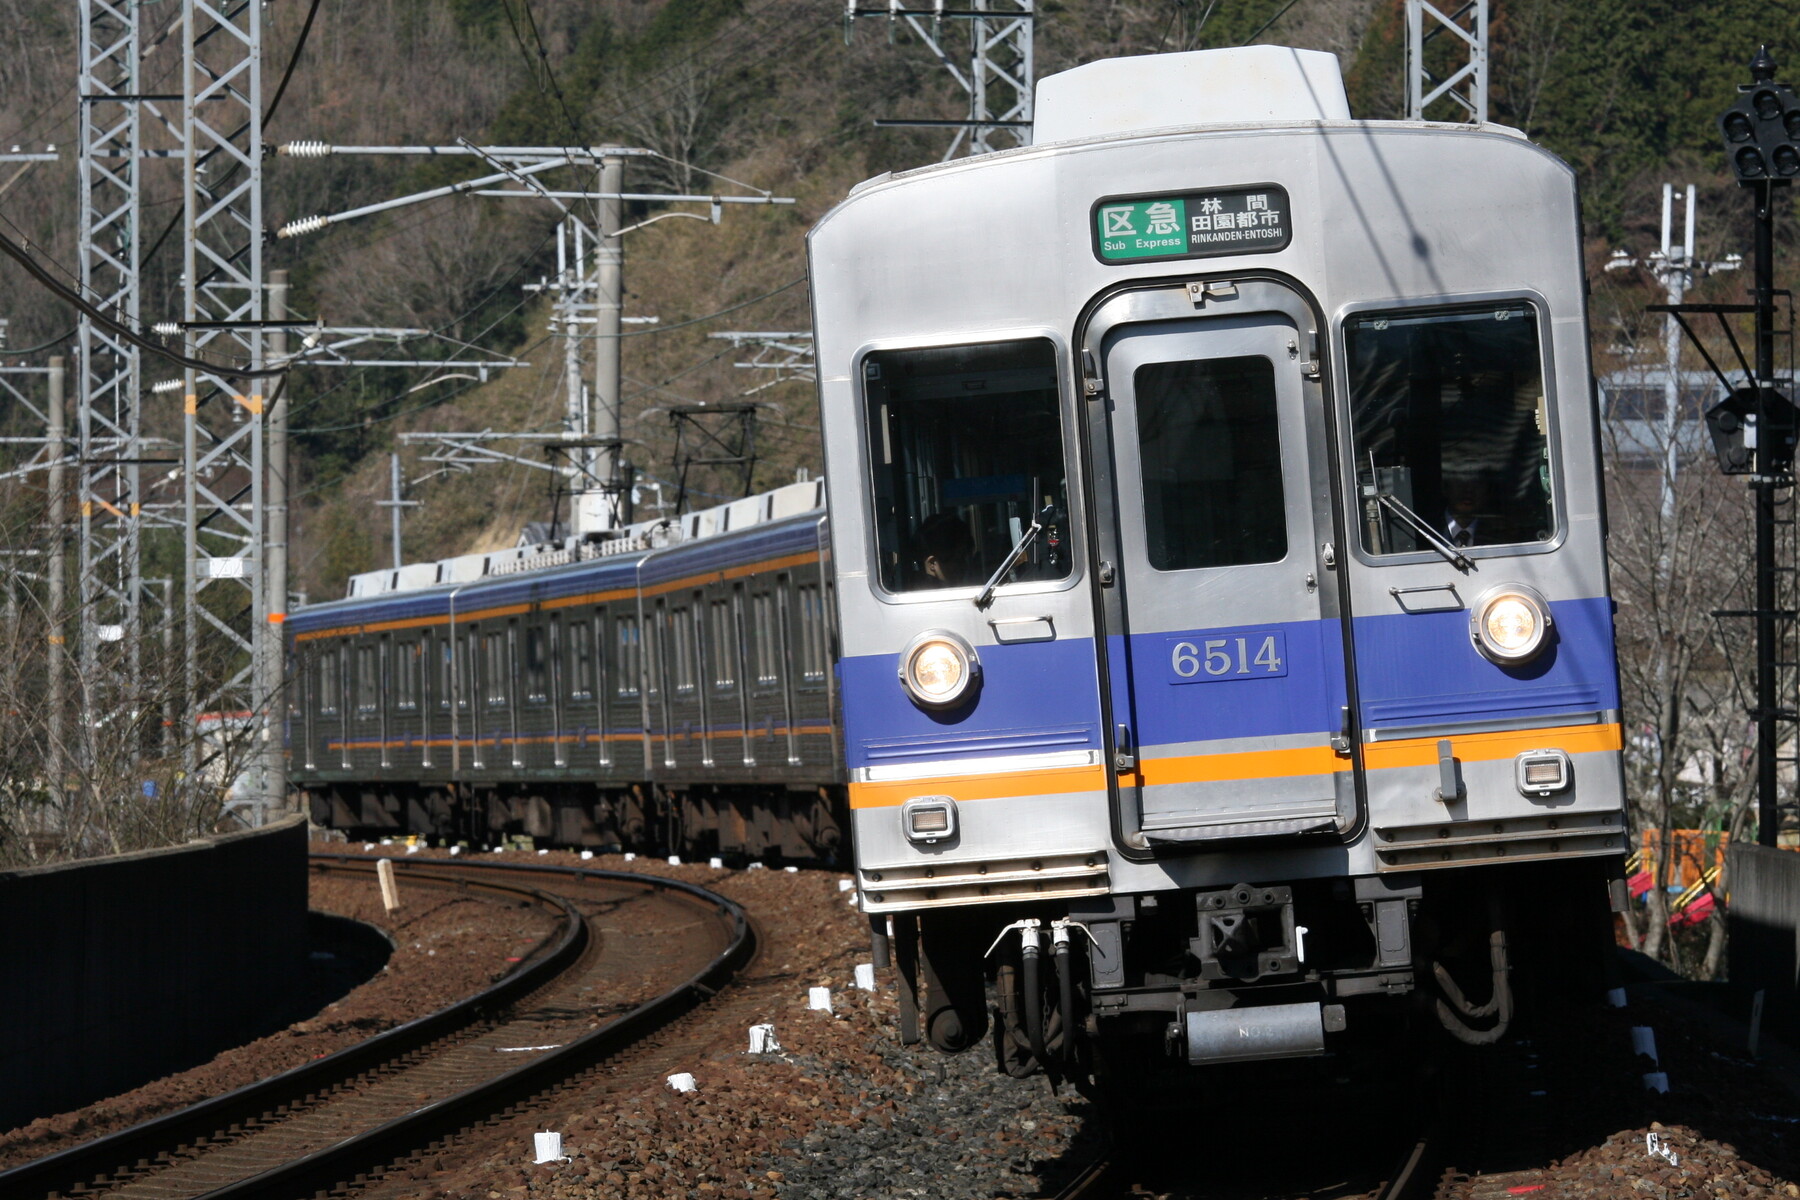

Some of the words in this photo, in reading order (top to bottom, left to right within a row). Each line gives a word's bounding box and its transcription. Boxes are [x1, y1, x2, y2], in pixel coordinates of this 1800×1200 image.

[1102, 202, 1180, 239] 区急
[1191, 209, 1280, 231] 田園都市
[1104, 239, 1126, 251] Sub
[1136, 238, 1181, 249] Express
[1172, 636, 1281, 677] 6514
